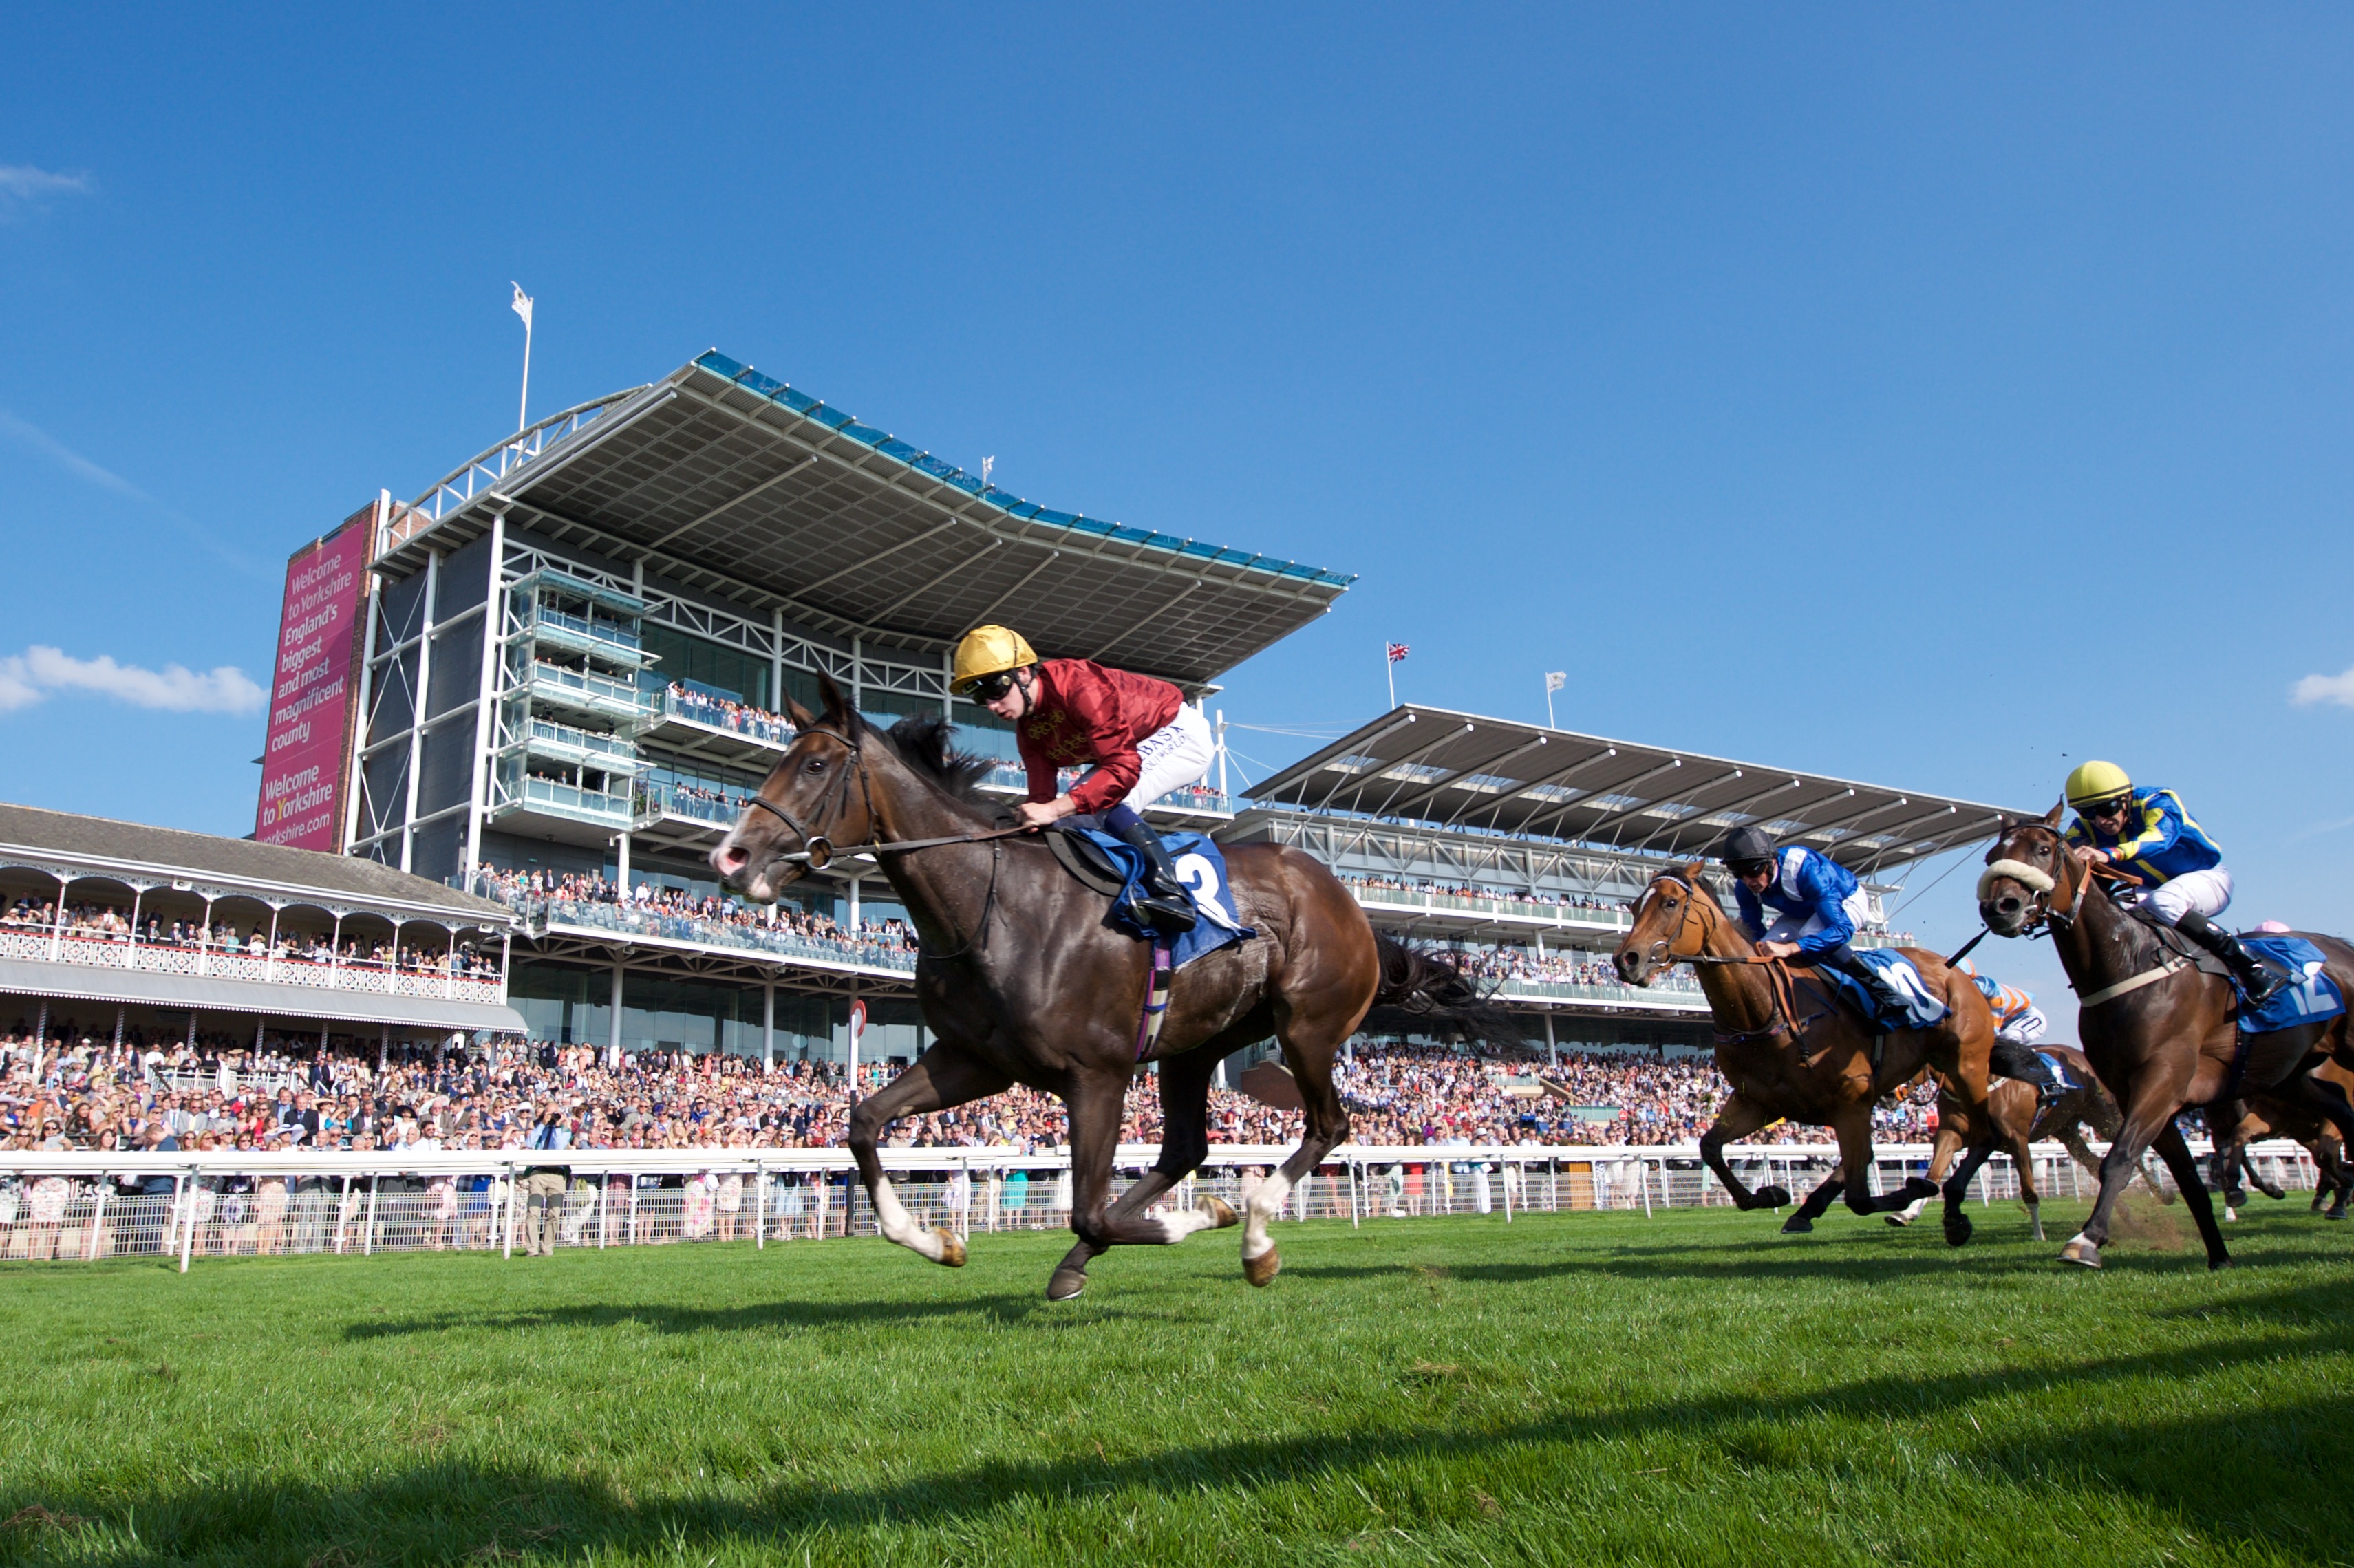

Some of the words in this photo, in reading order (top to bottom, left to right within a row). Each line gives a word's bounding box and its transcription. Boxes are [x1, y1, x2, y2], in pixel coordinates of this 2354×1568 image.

[292, 554, 341, 595] Welcome
[288, 602, 299, 621] to
[301, 572, 352, 613] Yorkshire
[284, 603, 338, 647] England's
[281, 635, 322, 673] biggest
[278, 671, 299, 699] and
[301, 656, 330, 687] most
[275, 674, 344, 725] magnificent
[271, 721, 310, 752] county
[263, 807, 275, 826] to
[277, 782, 332, 821] Yorkshire
[266, 765, 319, 802] Welcome
[2289, 961, 2338, 1016] 12
